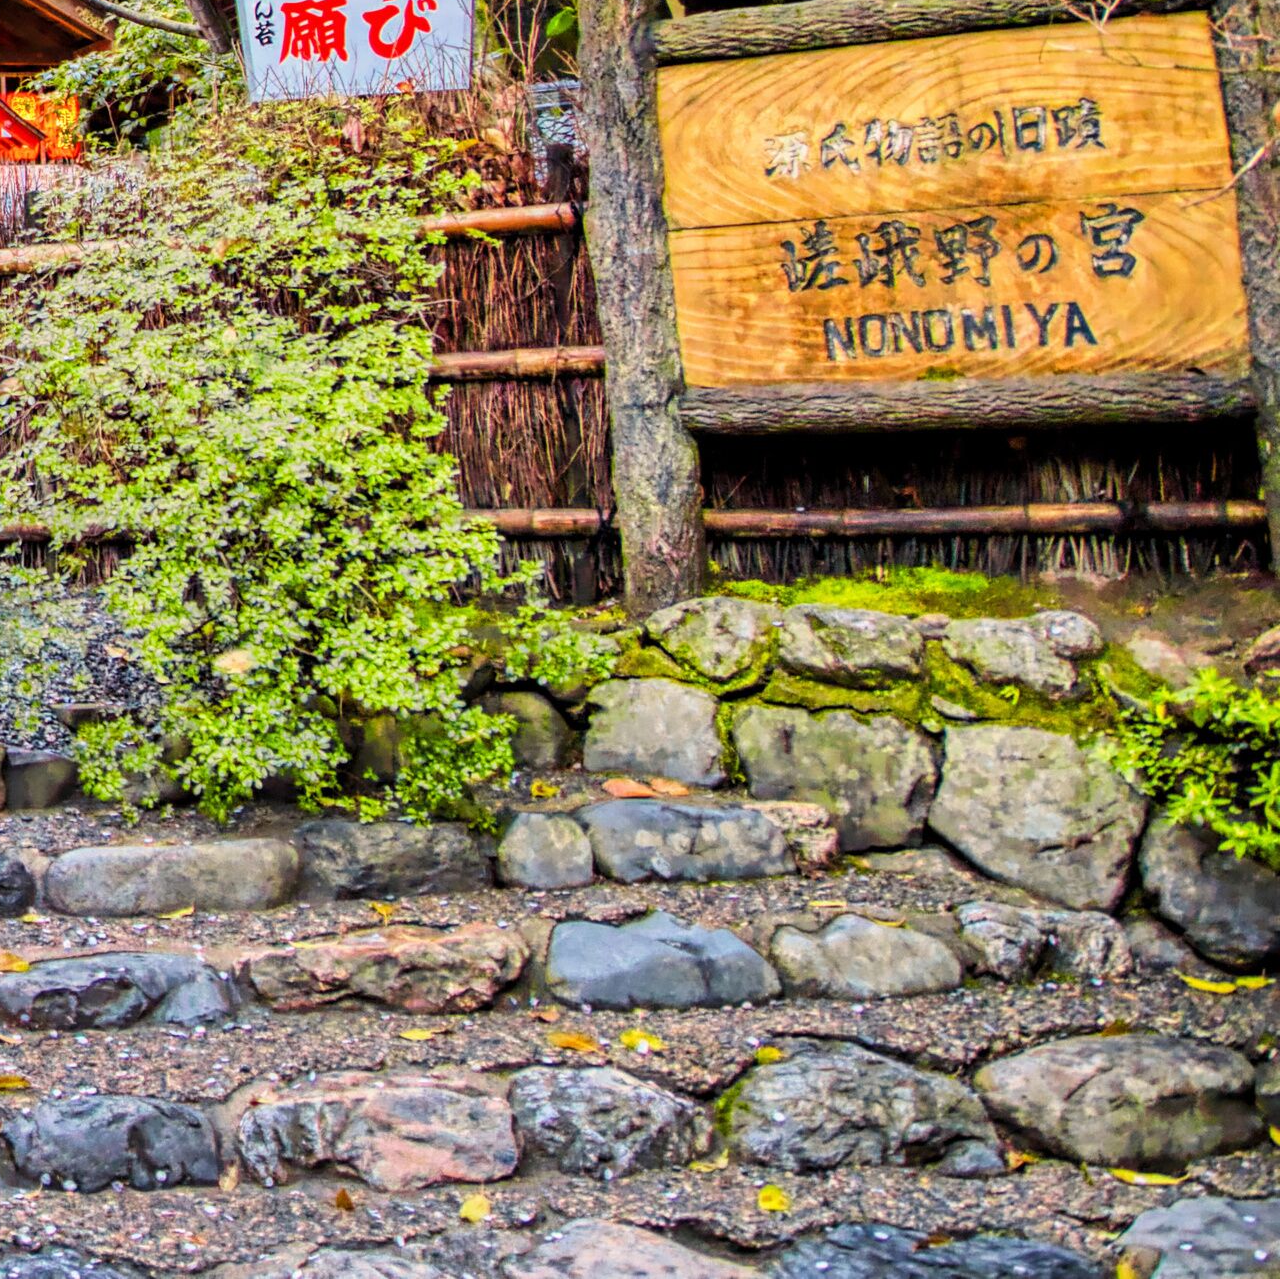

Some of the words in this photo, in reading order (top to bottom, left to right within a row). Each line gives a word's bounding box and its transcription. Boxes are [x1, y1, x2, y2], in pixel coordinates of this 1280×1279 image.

[764, 96, 1108, 181] 源氏物語の旧蹟
[779, 201, 1147, 295] 嵯峨野の宮
[824, 302, 1099, 362] NONOMIYA
